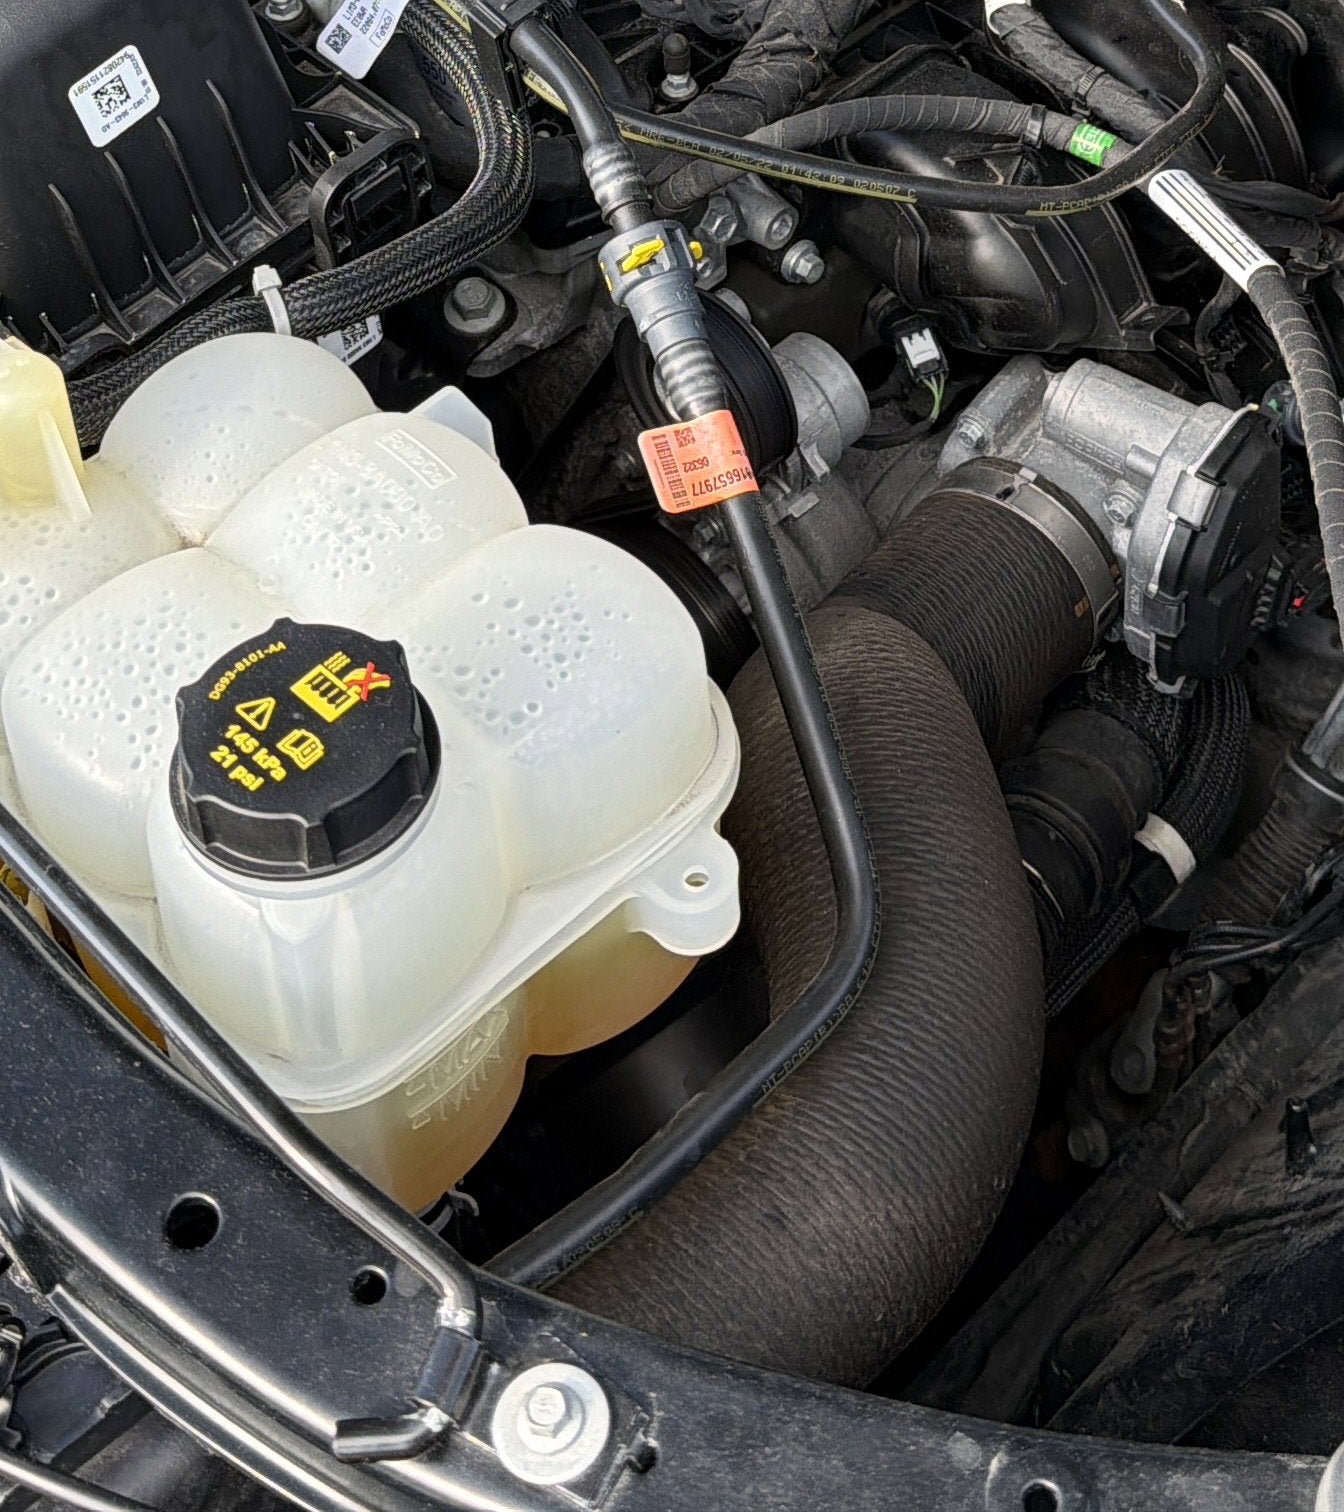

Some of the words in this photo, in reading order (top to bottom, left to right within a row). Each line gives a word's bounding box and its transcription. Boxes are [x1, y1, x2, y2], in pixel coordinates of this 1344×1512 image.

[374, 14, 392, 40] FoMoCo
[387, 432, 444, 484] FoMoCo
[209, 744, 238, 769] 21
[228, 764, 264, 792] psi
[224, 724, 260, 755] 145
[253, 747, 288, 782] kPa
